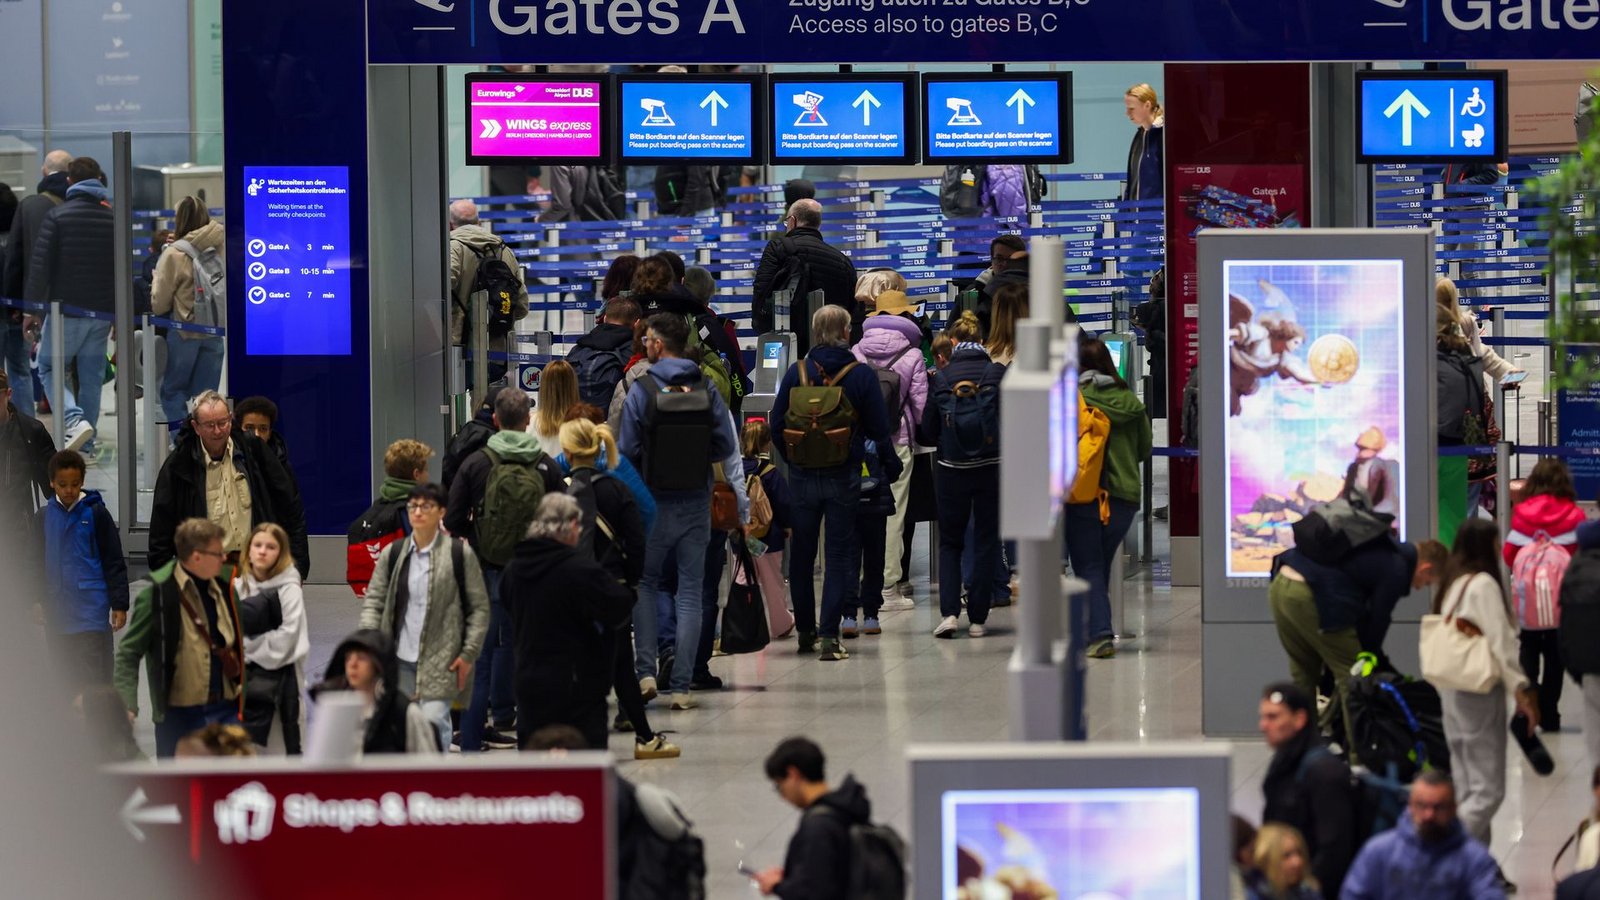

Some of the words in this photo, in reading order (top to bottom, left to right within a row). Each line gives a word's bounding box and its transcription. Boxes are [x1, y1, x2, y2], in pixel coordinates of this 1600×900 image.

[488, 0, 680, 35] Gates
[698, 0, 746, 34] A
[788, 14, 868, 34] Access
[874, 12, 918, 33] also
[922, 14, 944, 33] to
[950, 14, 1010, 38] gates
[477, 90, 516, 99] Eurowings
[572, 88, 593, 98] DUS
[505, 119, 548, 130] WINGS
[549, 121, 592, 132] express
[728, 133, 744, 141] legen
[880, 133, 897, 141] legen
[1252, 187, 1278, 195] Gates
[1571, 429, 1600, 437] Admitt
[283, 793, 380, 833] Shops
[380, 791, 406, 827] &
[407, 791, 585, 826] Restaurants
